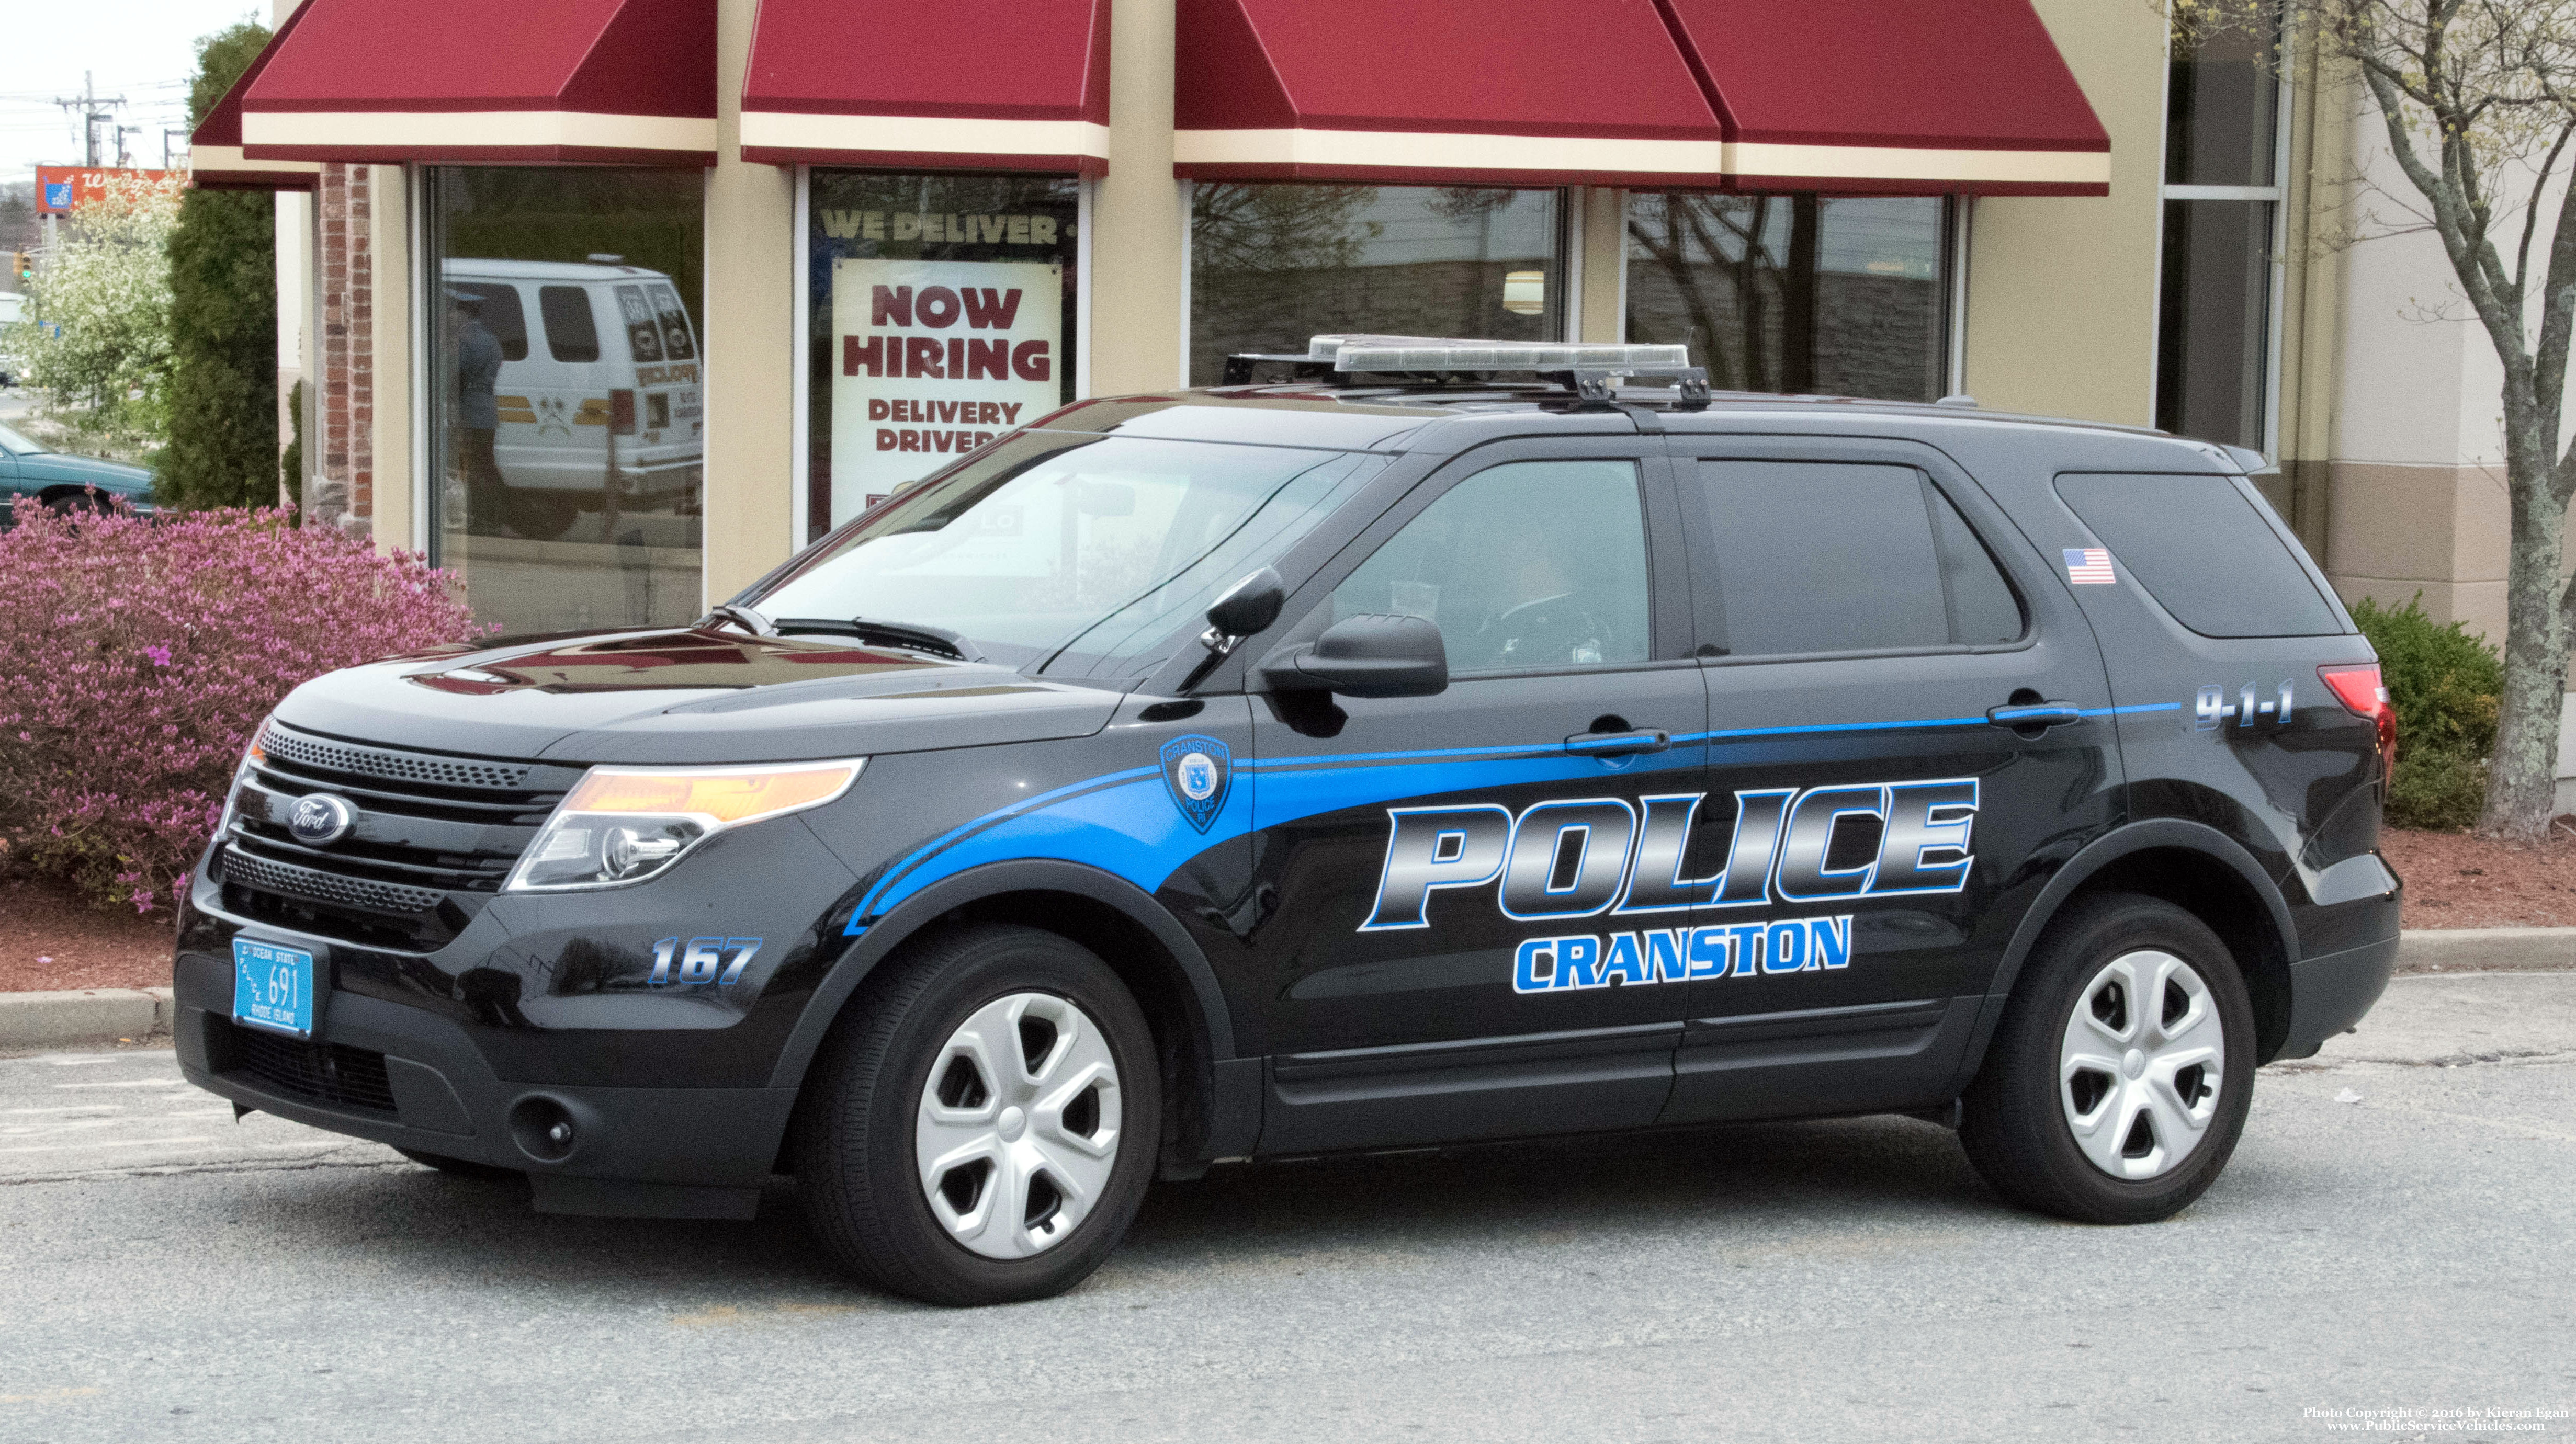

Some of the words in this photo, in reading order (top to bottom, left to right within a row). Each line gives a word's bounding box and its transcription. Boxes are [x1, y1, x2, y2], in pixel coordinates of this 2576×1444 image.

[821, 209, 885, 240] WE
[893, 211, 1058, 245] DELIVER
[871, 285, 1023, 329] NOW
[843, 335, 1050, 381] HIRING
[868, 399, 1023, 425] DELIVERY
[876, 428, 1005, 453] DRIVER
[2196, 678, 2293, 731] 9-1-1
[1165, 740, 1226, 762] CRANSTON
[293, 801, 330, 830] Ford
[1184, 794, 1215, 813] POLICE
[1355, 777, 1980, 933] POLICE
[253, 946, 273, 961] OCEAN
[647, 936, 763, 985] 167
[1512, 914, 1854, 994] CRANSTON
[268, 965, 298, 1009] 691
[251, 1003, 272, 1019] RHODE
[273, 1008, 295, 1025] ISLAND
